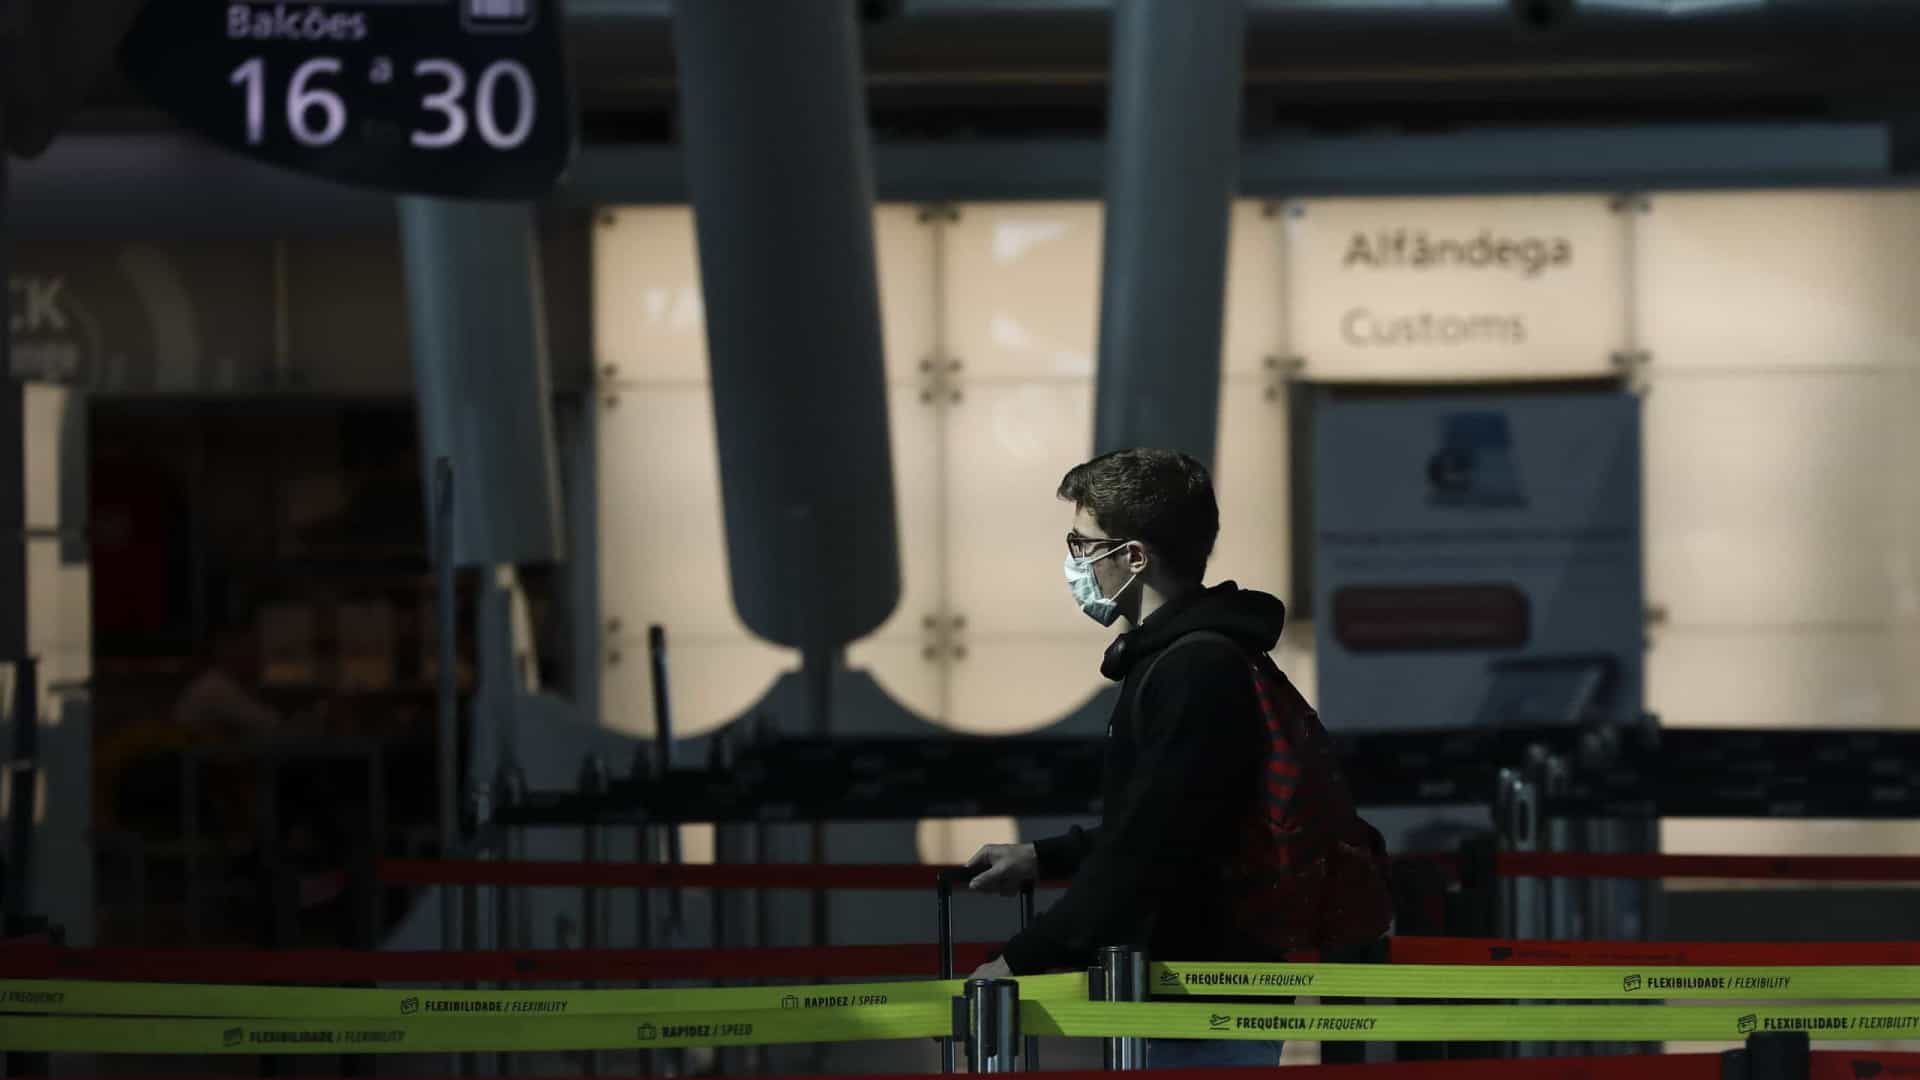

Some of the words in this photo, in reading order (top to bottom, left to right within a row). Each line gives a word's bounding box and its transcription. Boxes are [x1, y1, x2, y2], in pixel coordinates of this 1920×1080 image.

[226, 3, 368, 40] Balcões
[228, 56, 347, 147] 16
[409, 58, 536, 149] 30
[1343, 228, 1572, 277] Alfândega
[1341, 307, 1527, 346] Customs
[1186, 972, 1249, 985] FREQUÊNCIA
[1259, 974, 1314, 985] FREQUENCY
[1648, 978, 1725, 988] FLEXIBILIDADE
[1735, 977, 1791, 988] FLEXIBILITY
[425, 1000, 502, 1012] FLEXIBILIDADE
[512, 1000, 568, 1012] FLEXIBILITY
[805, 997, 849, 1008] RAPIDEZ
[859, 996, 888, 1005] SPEED
[1237, 1016, 1306, 1029] FREQUÊNCIA
[1316, 1018, 1377, 1030] FREQUENCY
[1764, 1018, 1848, 1029] FLEXIBILIDADE
[1859, 1016, 1919, 1029] FLEXIBILITY
[662, 1026, 711, 1037] RAPIDEZ
[722, 1024, 752, 1036] SPEED
